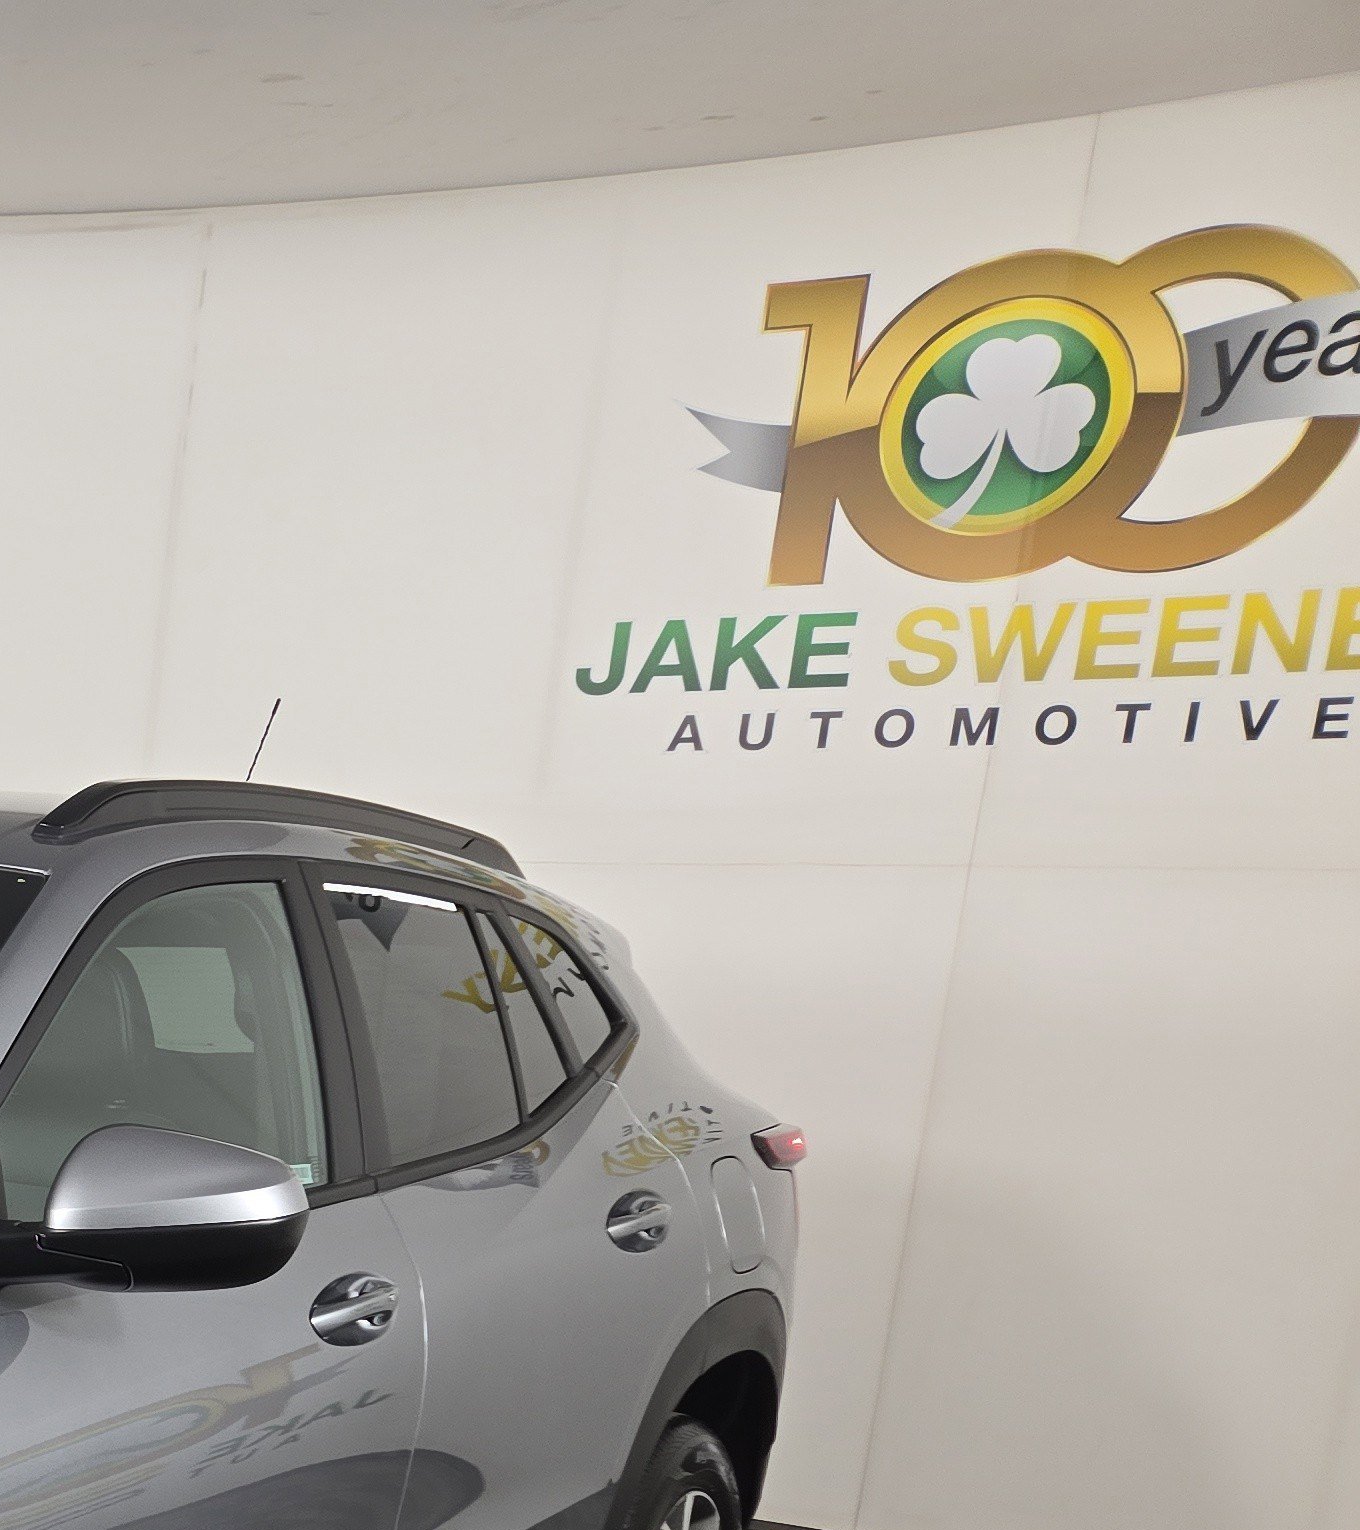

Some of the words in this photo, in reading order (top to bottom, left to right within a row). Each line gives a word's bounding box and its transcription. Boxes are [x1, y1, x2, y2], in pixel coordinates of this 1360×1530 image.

[761, 223, 1360, 587] 100
[574, 611, 858, 696] JAKE
[666, 696, 1355, 752] AUTOMOTIVE
